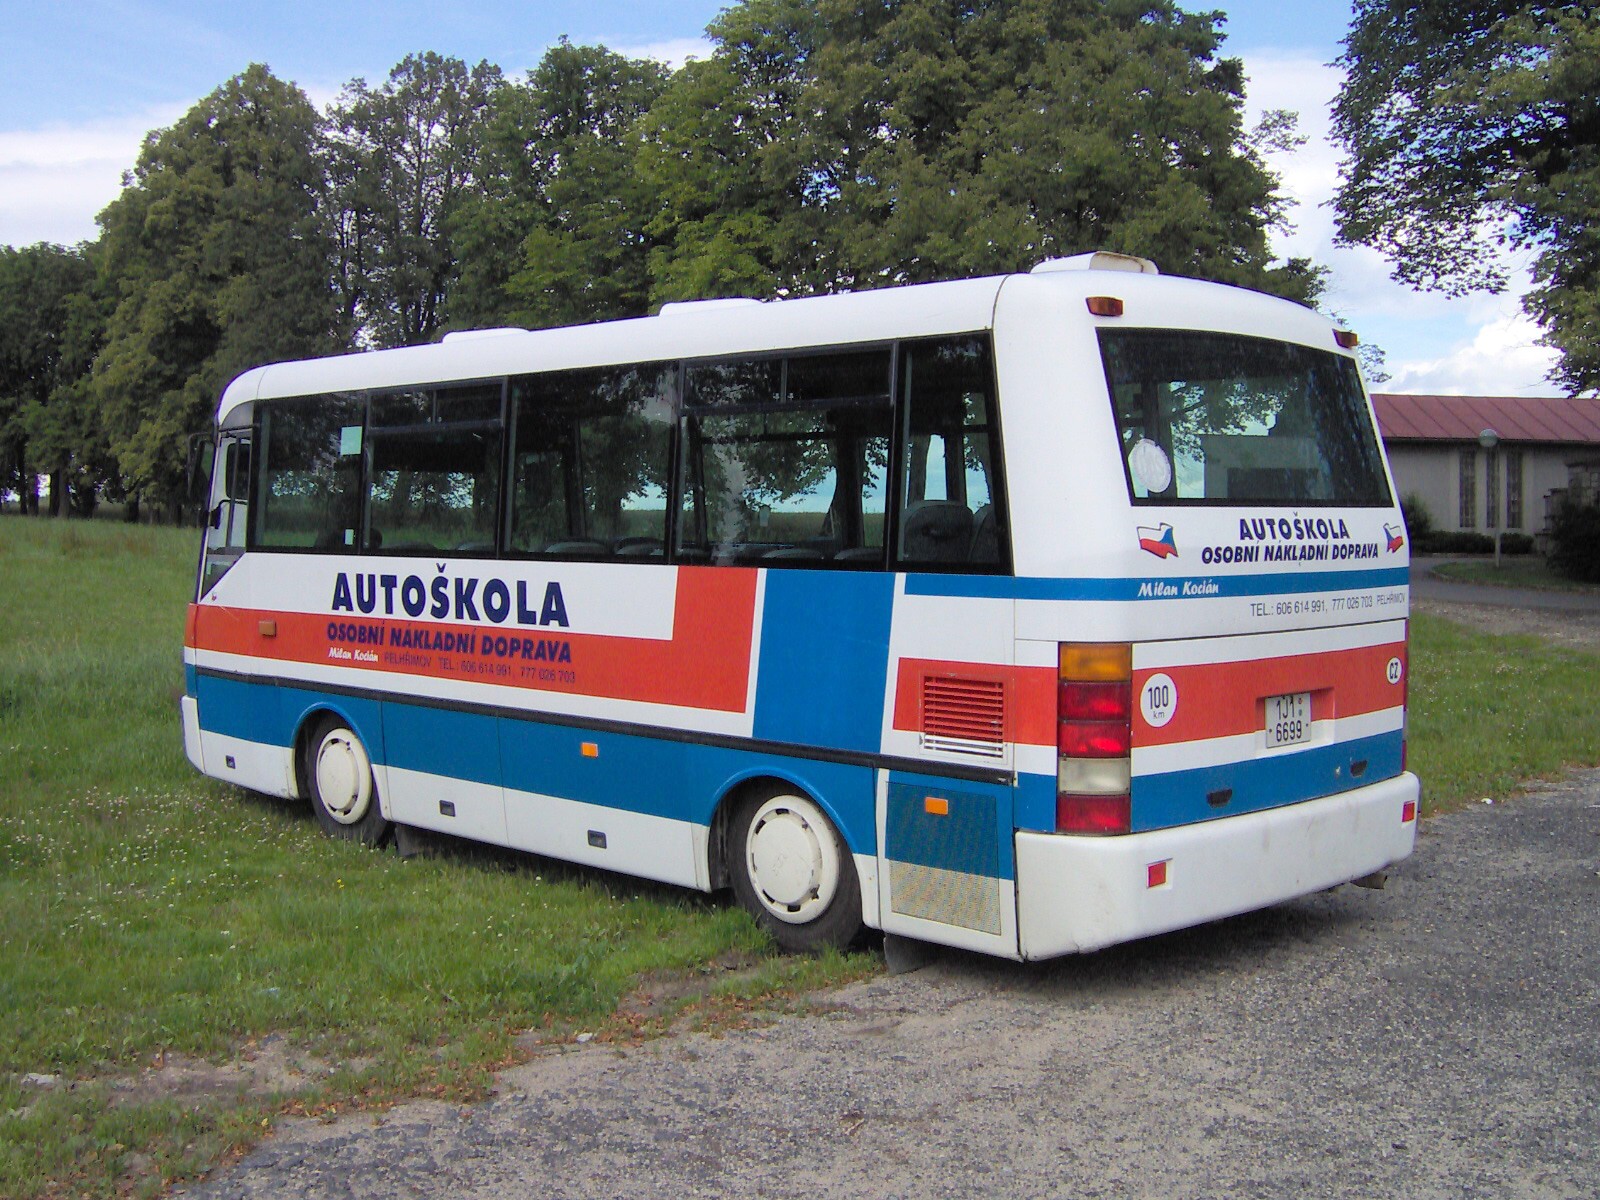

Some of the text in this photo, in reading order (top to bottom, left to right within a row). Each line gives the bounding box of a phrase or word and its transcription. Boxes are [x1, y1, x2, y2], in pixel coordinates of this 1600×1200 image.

[1239, 511, 1350, 540] AUTOŠKOLA
[1201, 540, 1379, 564] OSOBNÍ NÁKLADNÍ DOPRAVA
[331, 562, 570, 628] AUTOŠKOLA
[1137, 579, 1219, 597] Milan Kocián
[1276, 601, 1292, 615] 606
[1294, 600, 1310, 614] 614
[1332, 598, 1345, 611] 777
[1346, 597, 1360, 610] 026
[1361, 596, 1373, 608] 703
[327, 619, 573, 664] OSOBNÍ NÁKLADNÍ DOPRAVA
[328, 646, 352, 660] Milan
[460, 661, 476, 674] 606
[478, 662, 494, 675] 614
[520, 666, 536, 679] 777
[538, 668, 556, 682] 026
[558, 670, 576, 684] 703
[1389, 662, 1399, 679] CZ
[1147, 684, 1169, 710] 100
[1153, 709, 1165, 719] km
[1275, 720, 1302, 742] 6699
